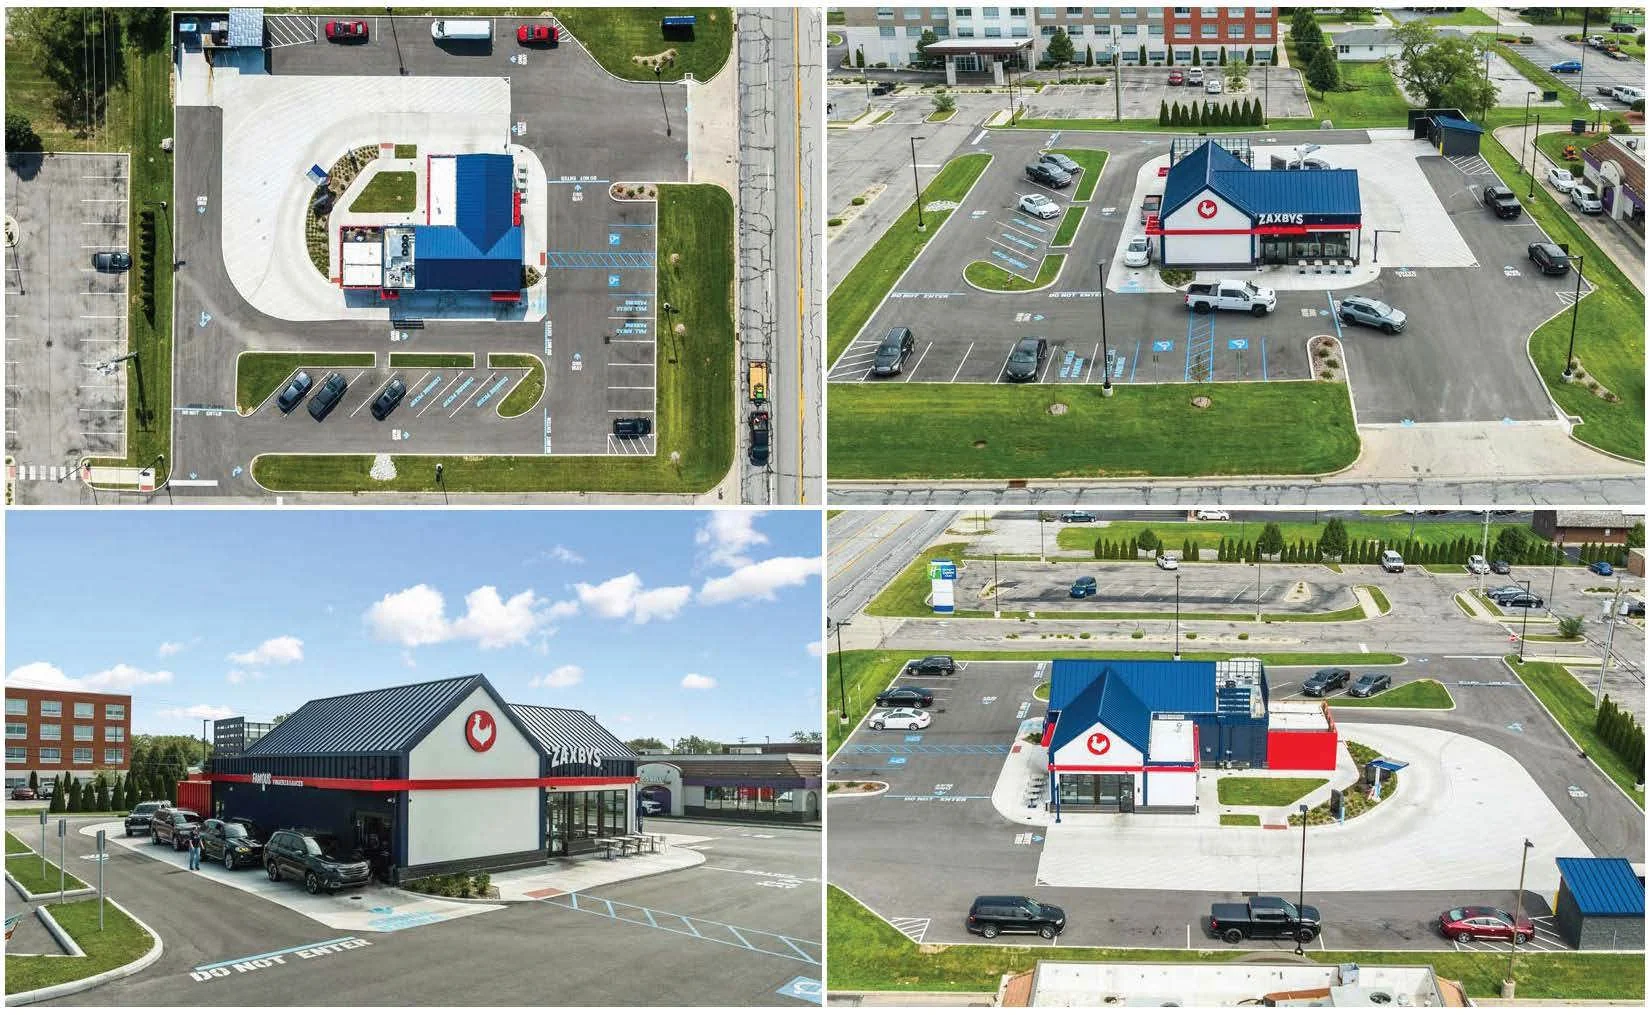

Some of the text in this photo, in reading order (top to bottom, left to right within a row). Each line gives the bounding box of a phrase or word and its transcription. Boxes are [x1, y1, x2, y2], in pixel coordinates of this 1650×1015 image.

[1258, 213, 1304, 225] ZAXBYS
[551, 746, 602, 768] ZAXBYS
[252, 772, 271, 785] FAMOUS
[190, 938, 373, 982] DO NOT ENTER
